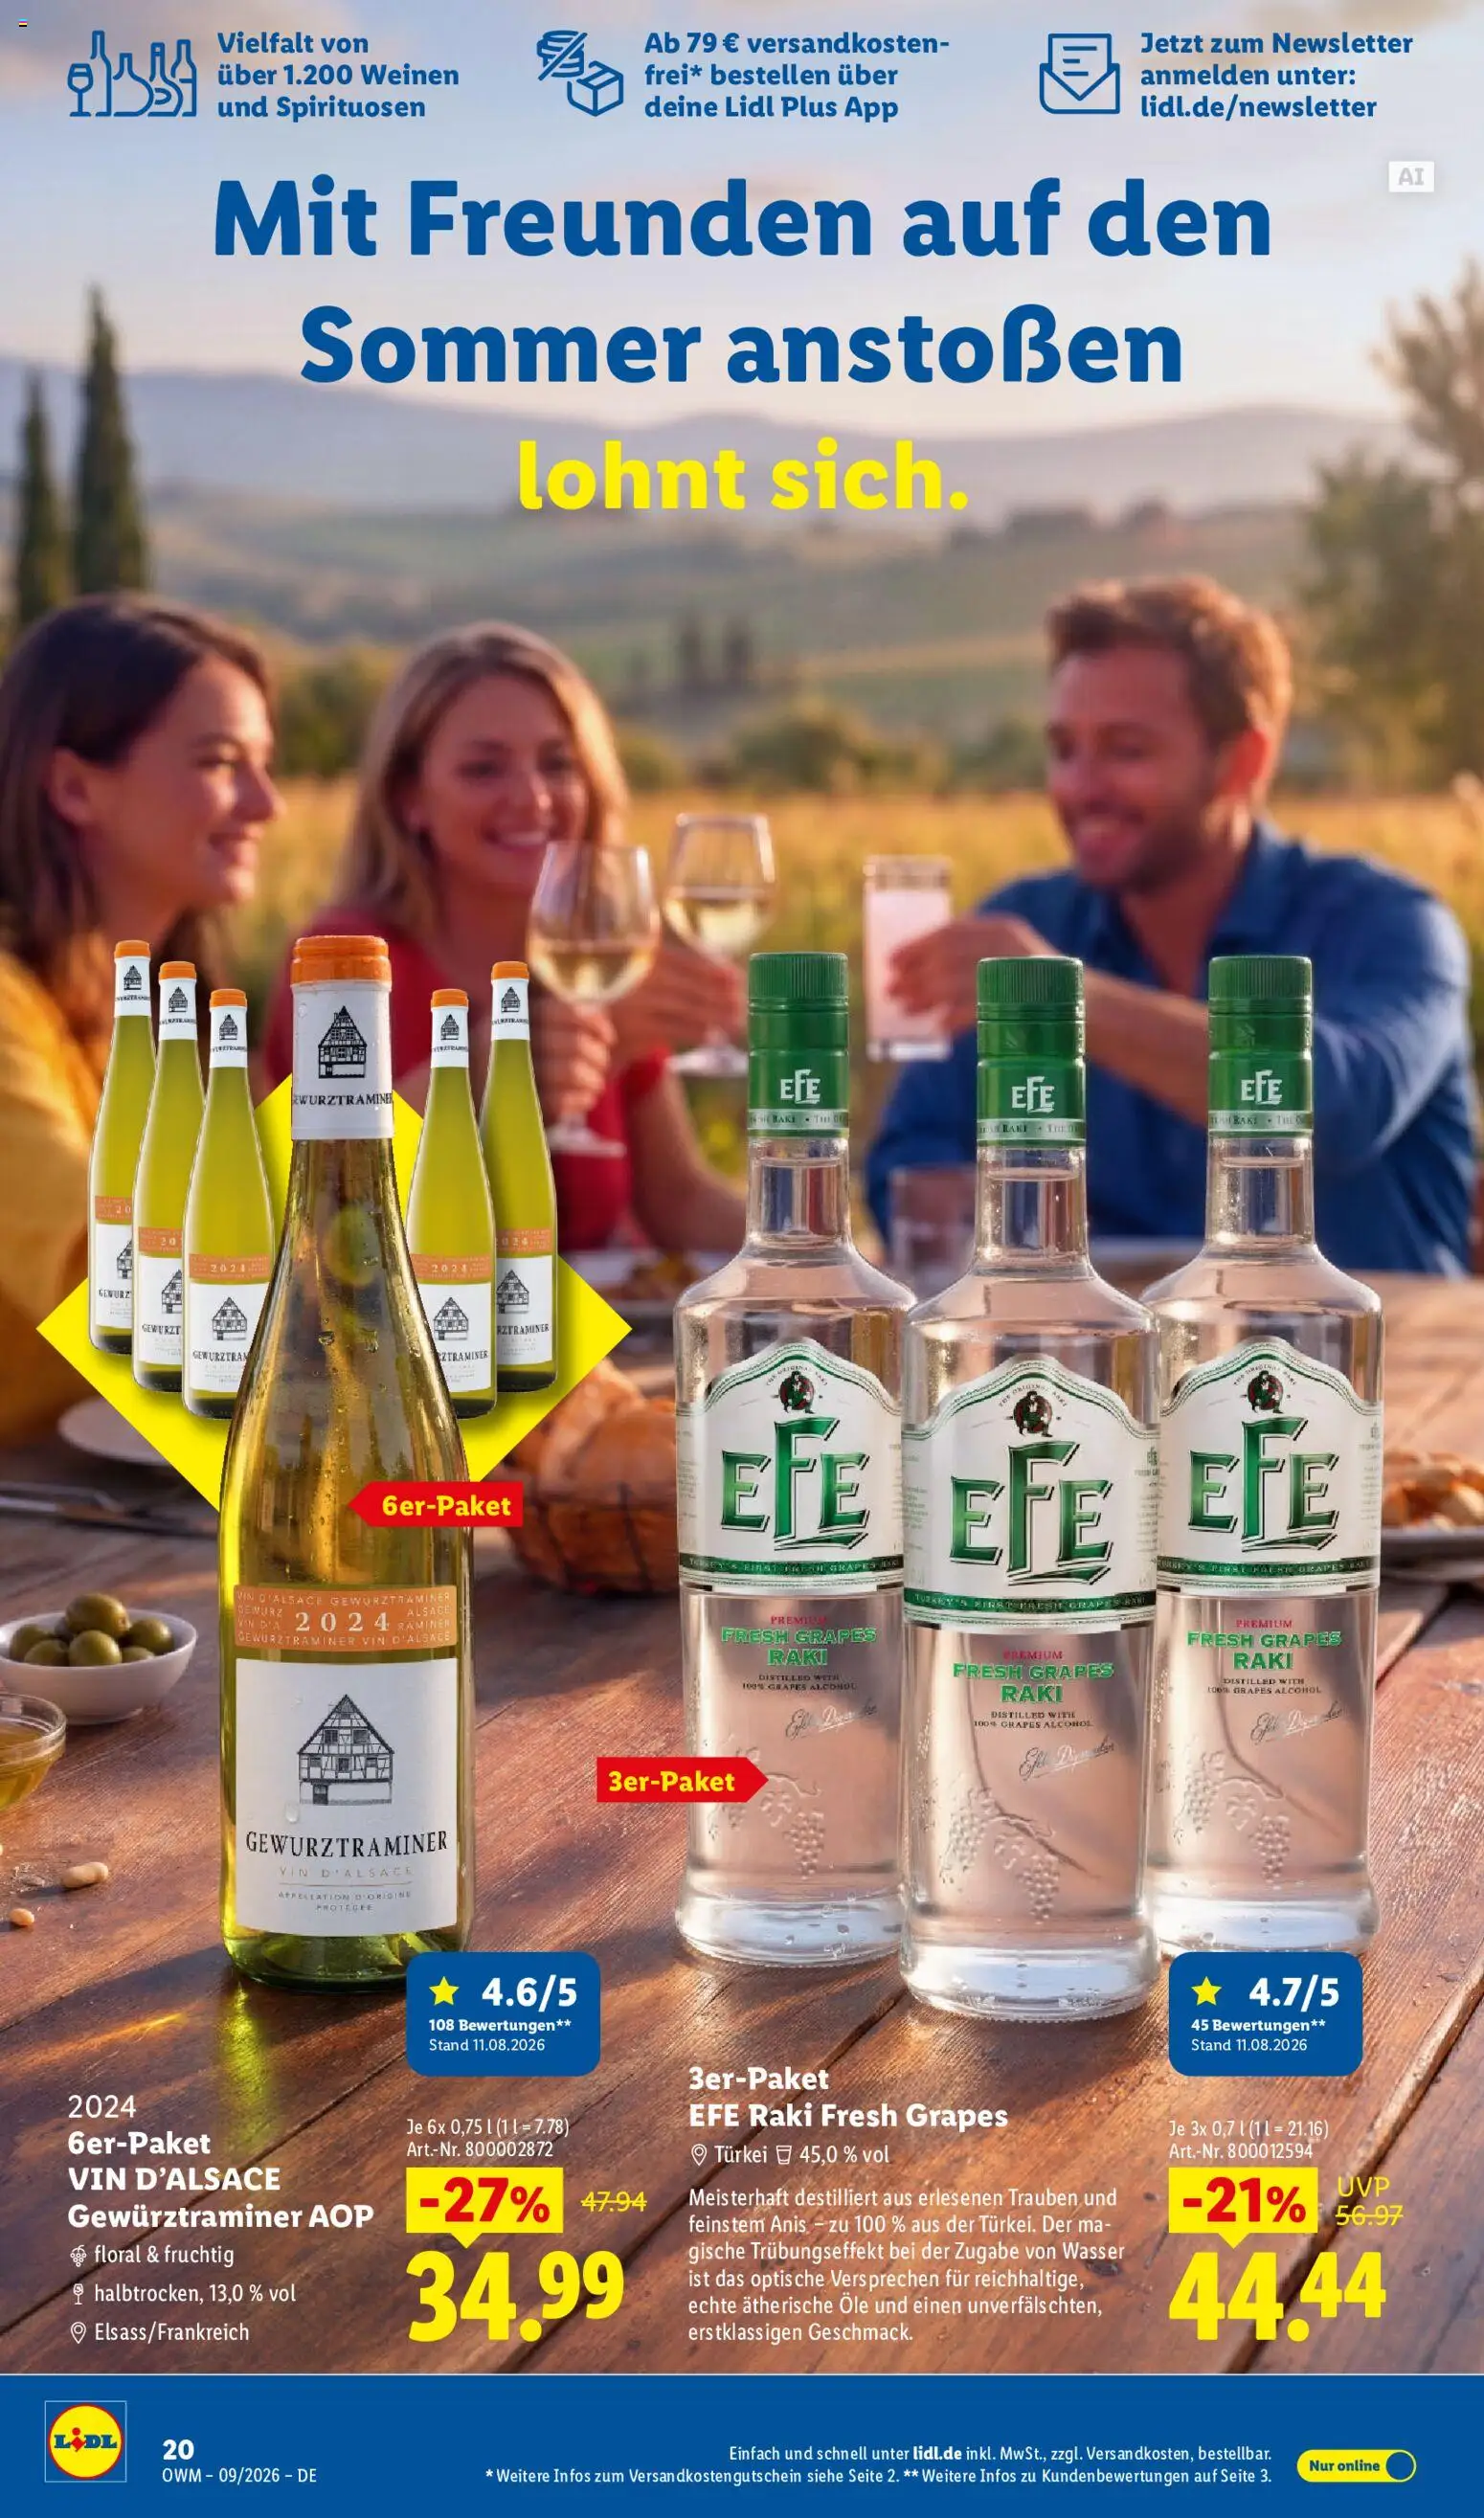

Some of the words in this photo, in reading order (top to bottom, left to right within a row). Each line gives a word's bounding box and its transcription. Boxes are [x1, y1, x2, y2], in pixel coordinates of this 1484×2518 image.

[217, 31, 314, 54] Vielfalt
[320, 37, 369, 55] von
[644, 31, 681, 55] Ab
[686, 32, 718, 54] 79
[722, 32, 740, 54] €
[747, 31, 950, 55] versandkosten-
[1140, 32, 1204, 54] Jetzt
[1210, 37, 1264, 54] zum
[1272, 31, 1414, 54] Newsletter
[217, 63, 277, 86] über
[282, 63, 353, 85] 1.200
[360, 62, 460, 86] Weinen
[710, 63, 830, 86] bestellen
[838, 63, 899, 86] über
[1140, 63, 1270, 86] anmelden
[1277, 66, 1356, 86] unter:
[217, 95, 269, 118] und
[276, 94, 426, 124] Spirituosen
[644, 94, 718, 118] deine
[725, 94, 775, 118] Lidl
[780, 95, 838, 118] Plus
[843, 96, 899, 124] App
[1141, 94, 1378, 122] lidl.de/newsletter
[214, 173, 377, 257] Mit
[410, 178, 871, 258] Freunden
[903, 177, 1061, 258] auf
[1088, 178, 1270, 258] den
[301, 304, 702, 384] Sommer
[727, 304, 1181, 384] anstoßen
[518, 438, 747, 511] lohnt
[771, 436, 969, 511] sich.
[780, 1068, 821, 1104] EFE
[1012, 1075, 1055, 1113] EFE
[1242, 1069, 1283, 1106] EFE
[721, 1416, 870, 1552] EFE
[1188, 1416, 1339, 1552] EFE
[382, 1494, 511, 1517] 6er-Paket
[950, 1440, 1114, 1586] EFE
[295, 1611, 390, 1632] 2024
[721, 1628, 789, 1644] FRESH
[795, 1628, 877, 1645] GRAPES
[1186, 1631, 1254, 1648] FRESH
[1260, 1630, 1343, 1648] GRAPES
[768, 1649, 828, 1666] RAKI
[1233, 1652, 1294, 1670] RAKI
[953, 1662, 1023, 1680] FRESH
[1029, 1662, 1115, 1681] GRAPES
[1001, 1685, 1064, 1704] RAKI
[608, 1770, 735, 1792] 3er-Paket
[246, 1830, 448, 1857] GEWURZTRAMINER
[279, 1866, 309, 1878] VIN
[482, 1974, 577, 2012] 4.6/5
[1248, 1974, 1339, 2012] 4.7/5
[428, 2018, 455, 2032] 108
[1190, 2018, 1209, 2032] 45
[428, 2037, 470, 2053] Stand
[472, 2037, 546, 2053] 11.08.2026
[1190, 2037, 1231, 2053] Stand
[1235, 2037, 1309, 2053] 11.08.2026
[688, 2066, 829, 2091] 3er-Paket
[68, 2094, 137, 2119] 2024
[689, 2103, 740, 2127] EFE
[748, 2102, 813, 2127] Raki
[821, 2102, 898, 2127] Fresh
[906, 2102, 1008, 2133] Grapes
[407, 2119, 423, 2135] Je
[427, 2119, 445, 2135] 6x
[450, 2118, 483, 2137] 0,75
[487, 2118, 492, 2135] l
[496, 2118, 507, 2138] (1
[513, 2118, 518, 2135] l
[534, 2117, 569, 2138] 7.78)
[1169, 2120, 1185, 2137] Je
[1191, 2120, 1207, 2137] 3x
[1212, 2120, 1235, 2138] 0,7
[1240, 2120, 1245, 2137] l
[1248, 2120, 1260, 2140] (1
[1265, 2120, 1270, 2137] l
[1288, 2120, 1329, 2141] 21.16)
[68, 2130, 211, 2155] 6er-Paket
[407, 2141, 461, 2157] Art.-Nr.
[465, 2141, 553, 2157] 800002872
[714, 2145, 767, 2163] Türkei
[1169, 2143, 1224, 2159] Art.-Nr.
[1227, 2143, 1314, 2159] 800012594
[799, 2145, 838, 2166] 45,0
[843, 2145, 858, 2163] %
[862, 2145, 889, 2163] vol
[68, 2167, 126, 2191] VIN
[1337, 2176, 1390, 2198] UVP
[419, 2176, 551, 2223] -27%
[581, 2191, 647, 2213] 47.94
[689, 2188, 789, 2207] Meisterhaft
[795, 2188, 878, 2207] destilliert
[883, 2192, 912, 2207] aus
[918, 2188, 1002, 2206] erlesenen
[1008, 2188, 1078, 2207] Trauben
[1084, 2188, 1117, 2206] und
[1182, 2176, 1307, 2223] -21%
[68, 2203, 303, 2229] Gewürztraminer
[308, 2204, 374, 2228] AOP
[1336, 2204, 1404, 2226] 56.97
[94, 2244, 141, 2263] floral
[146, 2245, 160, 2263] &
[164, 2244, 234, 2268] fruchtig
[95, 2283, 204, 2305] halbtrocken,
[209, 2283, 243, 2305] 13,0
[249, 2283, 263, 2302] %
[269, 2283, 296, 2302] vol
[406, 2250, 624, 2342] 34.99
[1168, 2251, 1386, 2342] 44.44
[95, 2321, 249, 2345] Elsass/Frankreich
[688, 2322, 802, 2346] erstklassigen
[808, 2322, 913, 2341] Geschmack.
[162, 2439, 194, 2461] 20
[730, 2445, 780, 2461] Einfach
[785, 2445, 813, 2461] und
[817, 2445, 867, 2461] schnell
[872, 2448, 910, 2461] unter
[912, 2445, 962, 2461] lidl.de
[965, 2445, 996, 2461] inkl.
[1000, 2445, 1046, 2462] MwSt.,
[1050, 2445, 1083, 2464] zzgl.
[1086, 2445, 1194, 2462] Versandkosten,
[1198, 2445, 1271, 2461] bestellbar.
[162, 2467, 202, 2483] OWM
[218, 2466, 280, 2485] 09/2026
[297, 2468, 317, 2483] DE
[1309, 2460, 1335, 2472] Nur
[1337, 2459, 1381, 2472] online
